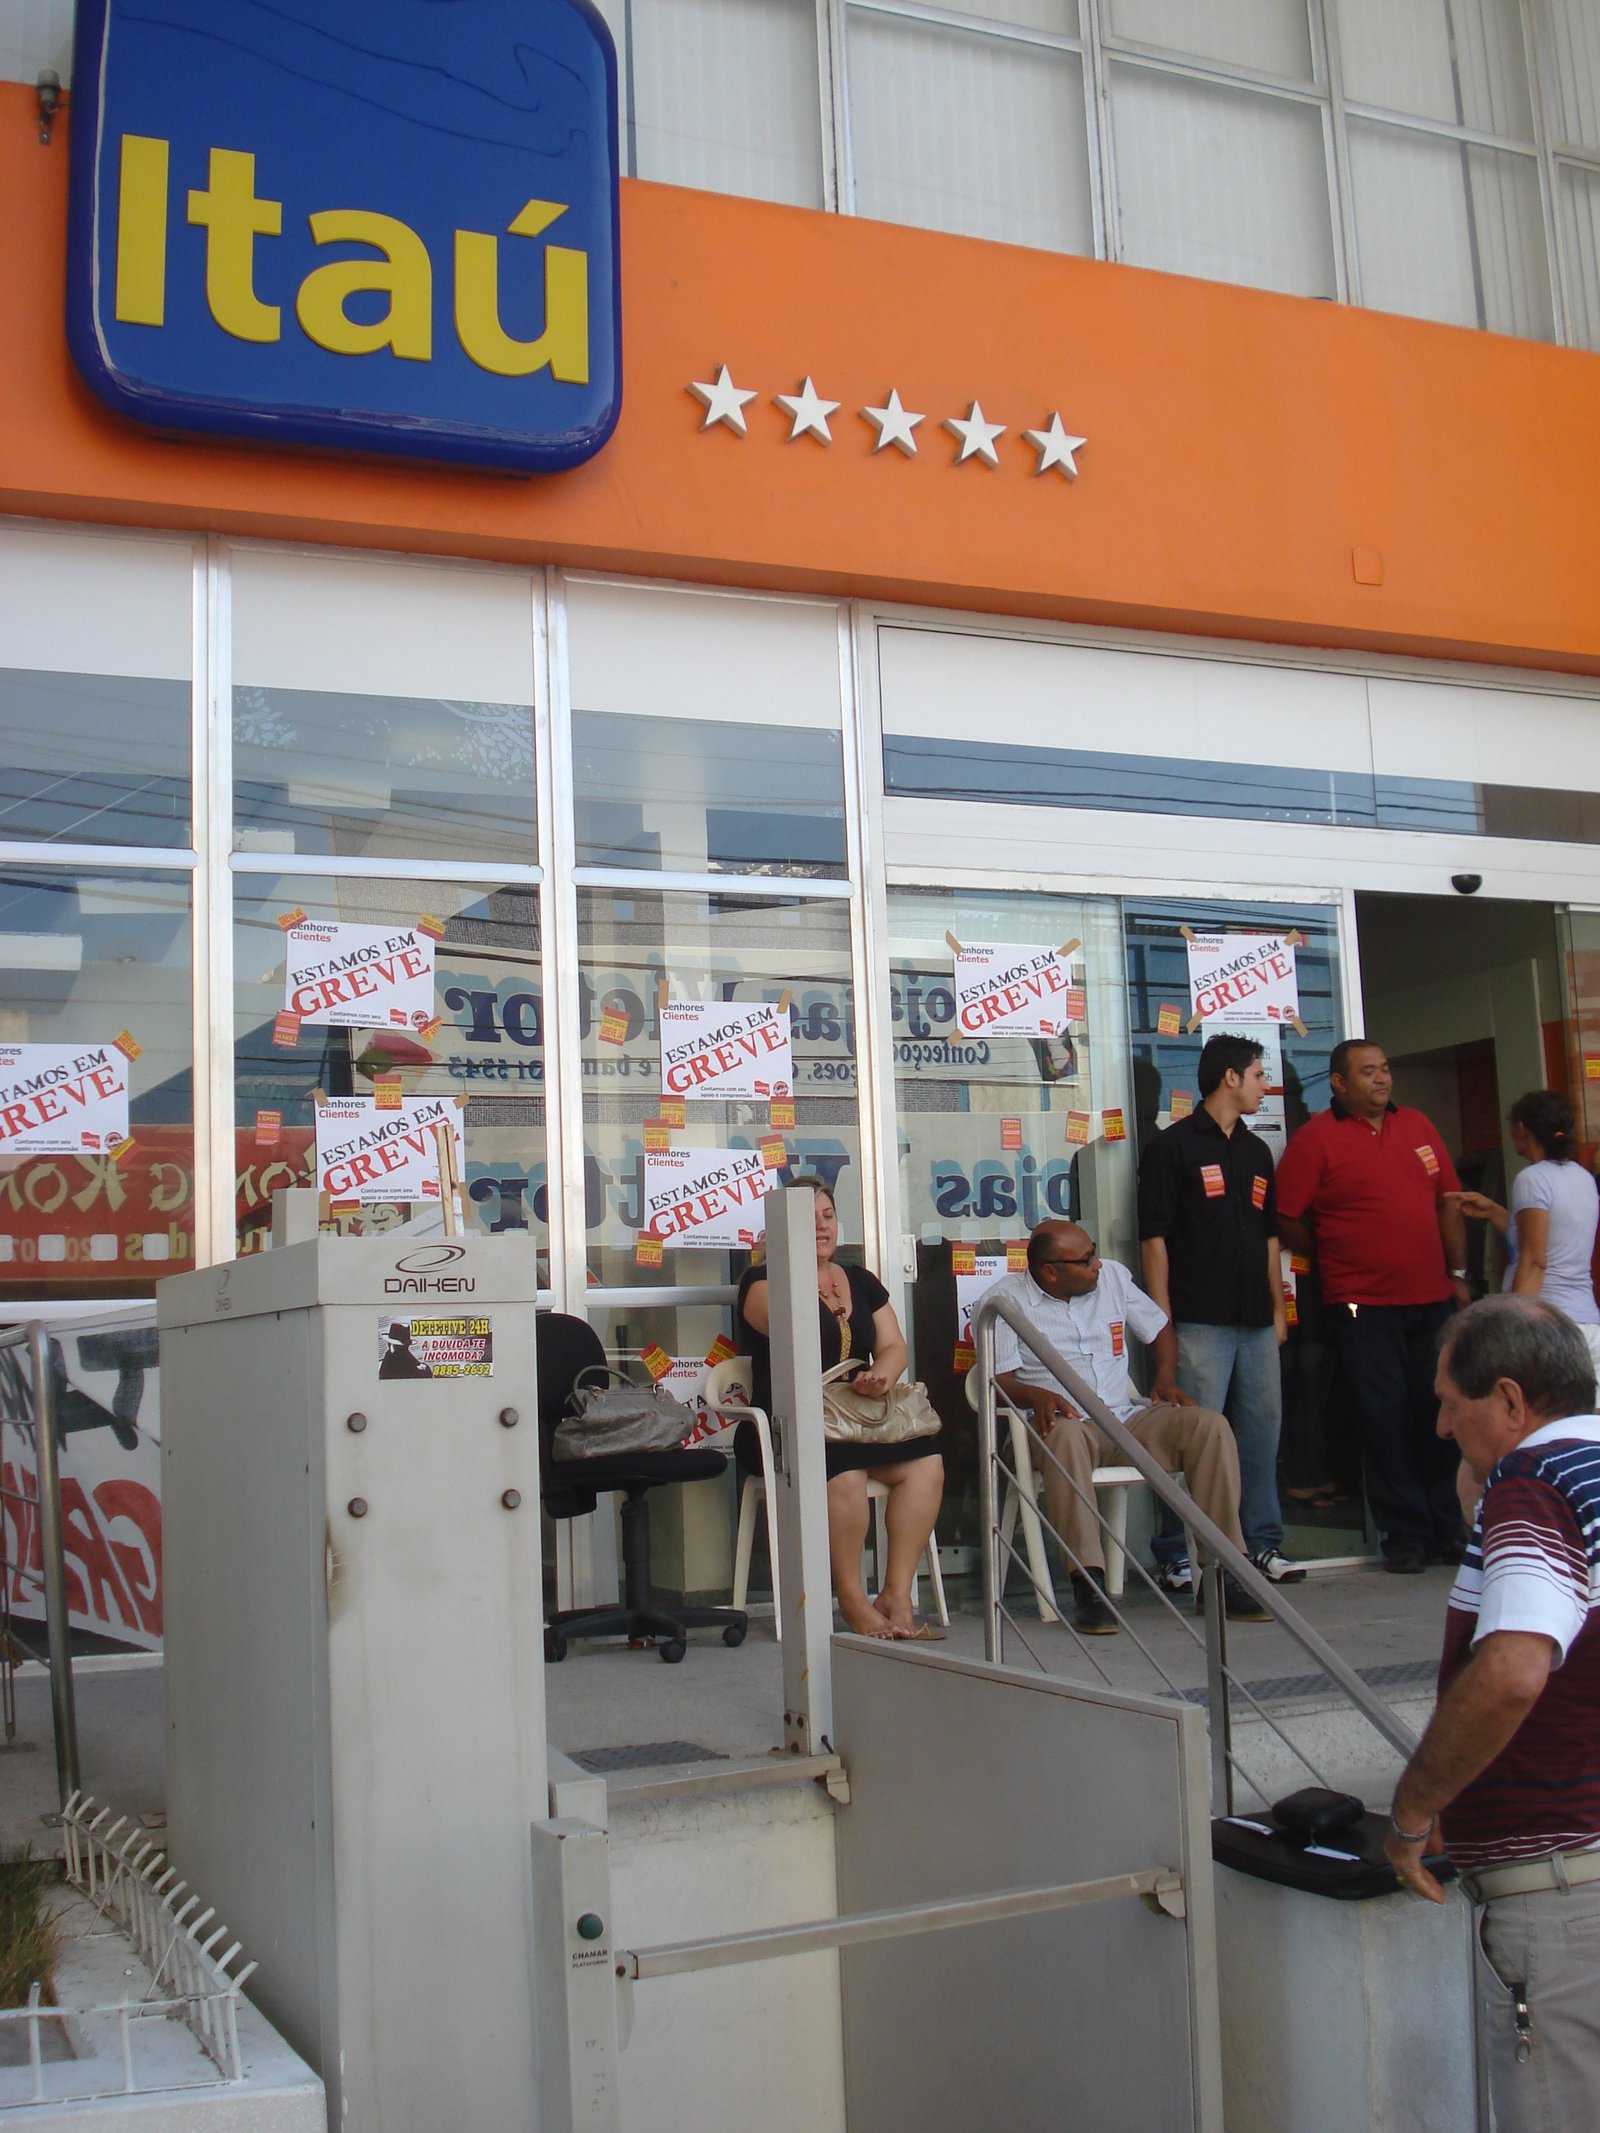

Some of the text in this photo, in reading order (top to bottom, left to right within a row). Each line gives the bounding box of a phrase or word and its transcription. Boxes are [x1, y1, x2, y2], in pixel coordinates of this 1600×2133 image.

[116, 133, 589, 384] Itaú
[290, 931, 332, 943] Clientes
[1194, 936, 1224, 944] enhores
[961, 947, 994, 955] enhores
[1190, 944, 1220, 952] Clientes
[291, 931, 417, 986] ESTAMOS EM
[957, 955, 989, 963] Clientes
[1194, 939, 1280, 991] ESTAMOS EM
[291, 947, 431, 1017] GREVE
[959, 951, 1056, 1004] ESTAMOS EM
[1196, 953, 1293, 1017] GREVE
[961, 964, 1069, 1031] GREVE
[664, 1003, 705, 1012] enhores
[662, 1012, 700, 1021] Clientes
[665, 1006, 774, 1064] ESTAMOS EM
[0, 1047, 22, 1055] ores
[666, 1021, 788, 1093] GREVE
[0, 1049, 108, 1104] TAMOS EM
[0, 1065, 125, 1140] REVE
[319, 1110, 360, 1119] Clientes
[321, 1101, 444, 1165] ESTAMOS EM
[647, 1157, 684, 1167] Clientes
[649, 1154, 760, 1211] ESTAMOS EM
[650, 1169, 773, 1240] GREVE
[411, 1319, 490, 1336] DETETIVE 24H
[421, 1340, 429, 1349] A
[472, 1339, 486, 1349] TE
[423, 1351, 484, 1361] INCOMODA?
[671, 1360, 704, 1368] nhores
[665, 1369, 698, 1378] lientes
[572, 1949, 608, 1960] CHAMAR
